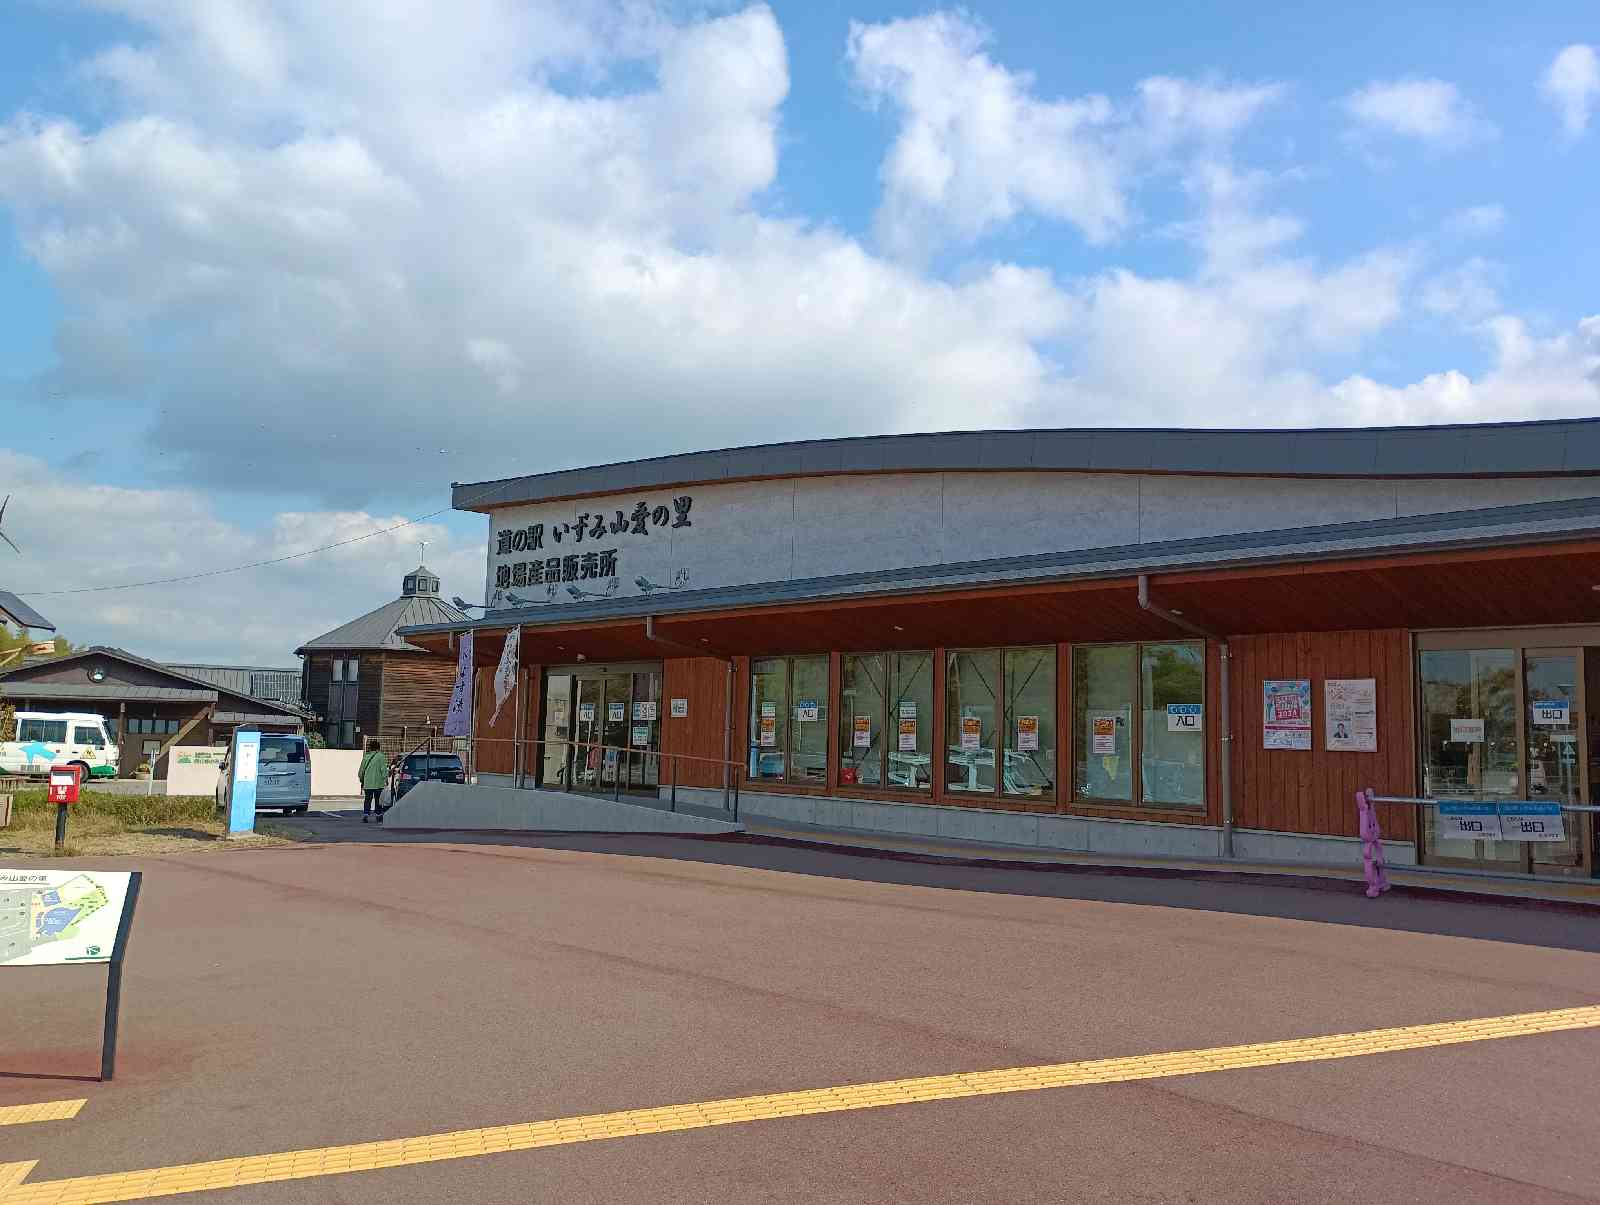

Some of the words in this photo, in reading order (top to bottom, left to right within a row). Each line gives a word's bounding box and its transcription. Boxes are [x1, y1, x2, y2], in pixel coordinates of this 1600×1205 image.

[496, 523, 543, 555] 道の駅
[496, 549, 617, 589] 地場産品販売所
[1542, 709, 1563, 719] 出口
[1176, 715, 1194, 726] 入口
[1459, 820, 1482, 832] 出口
[1520, 821, 1545, 832] 出口
